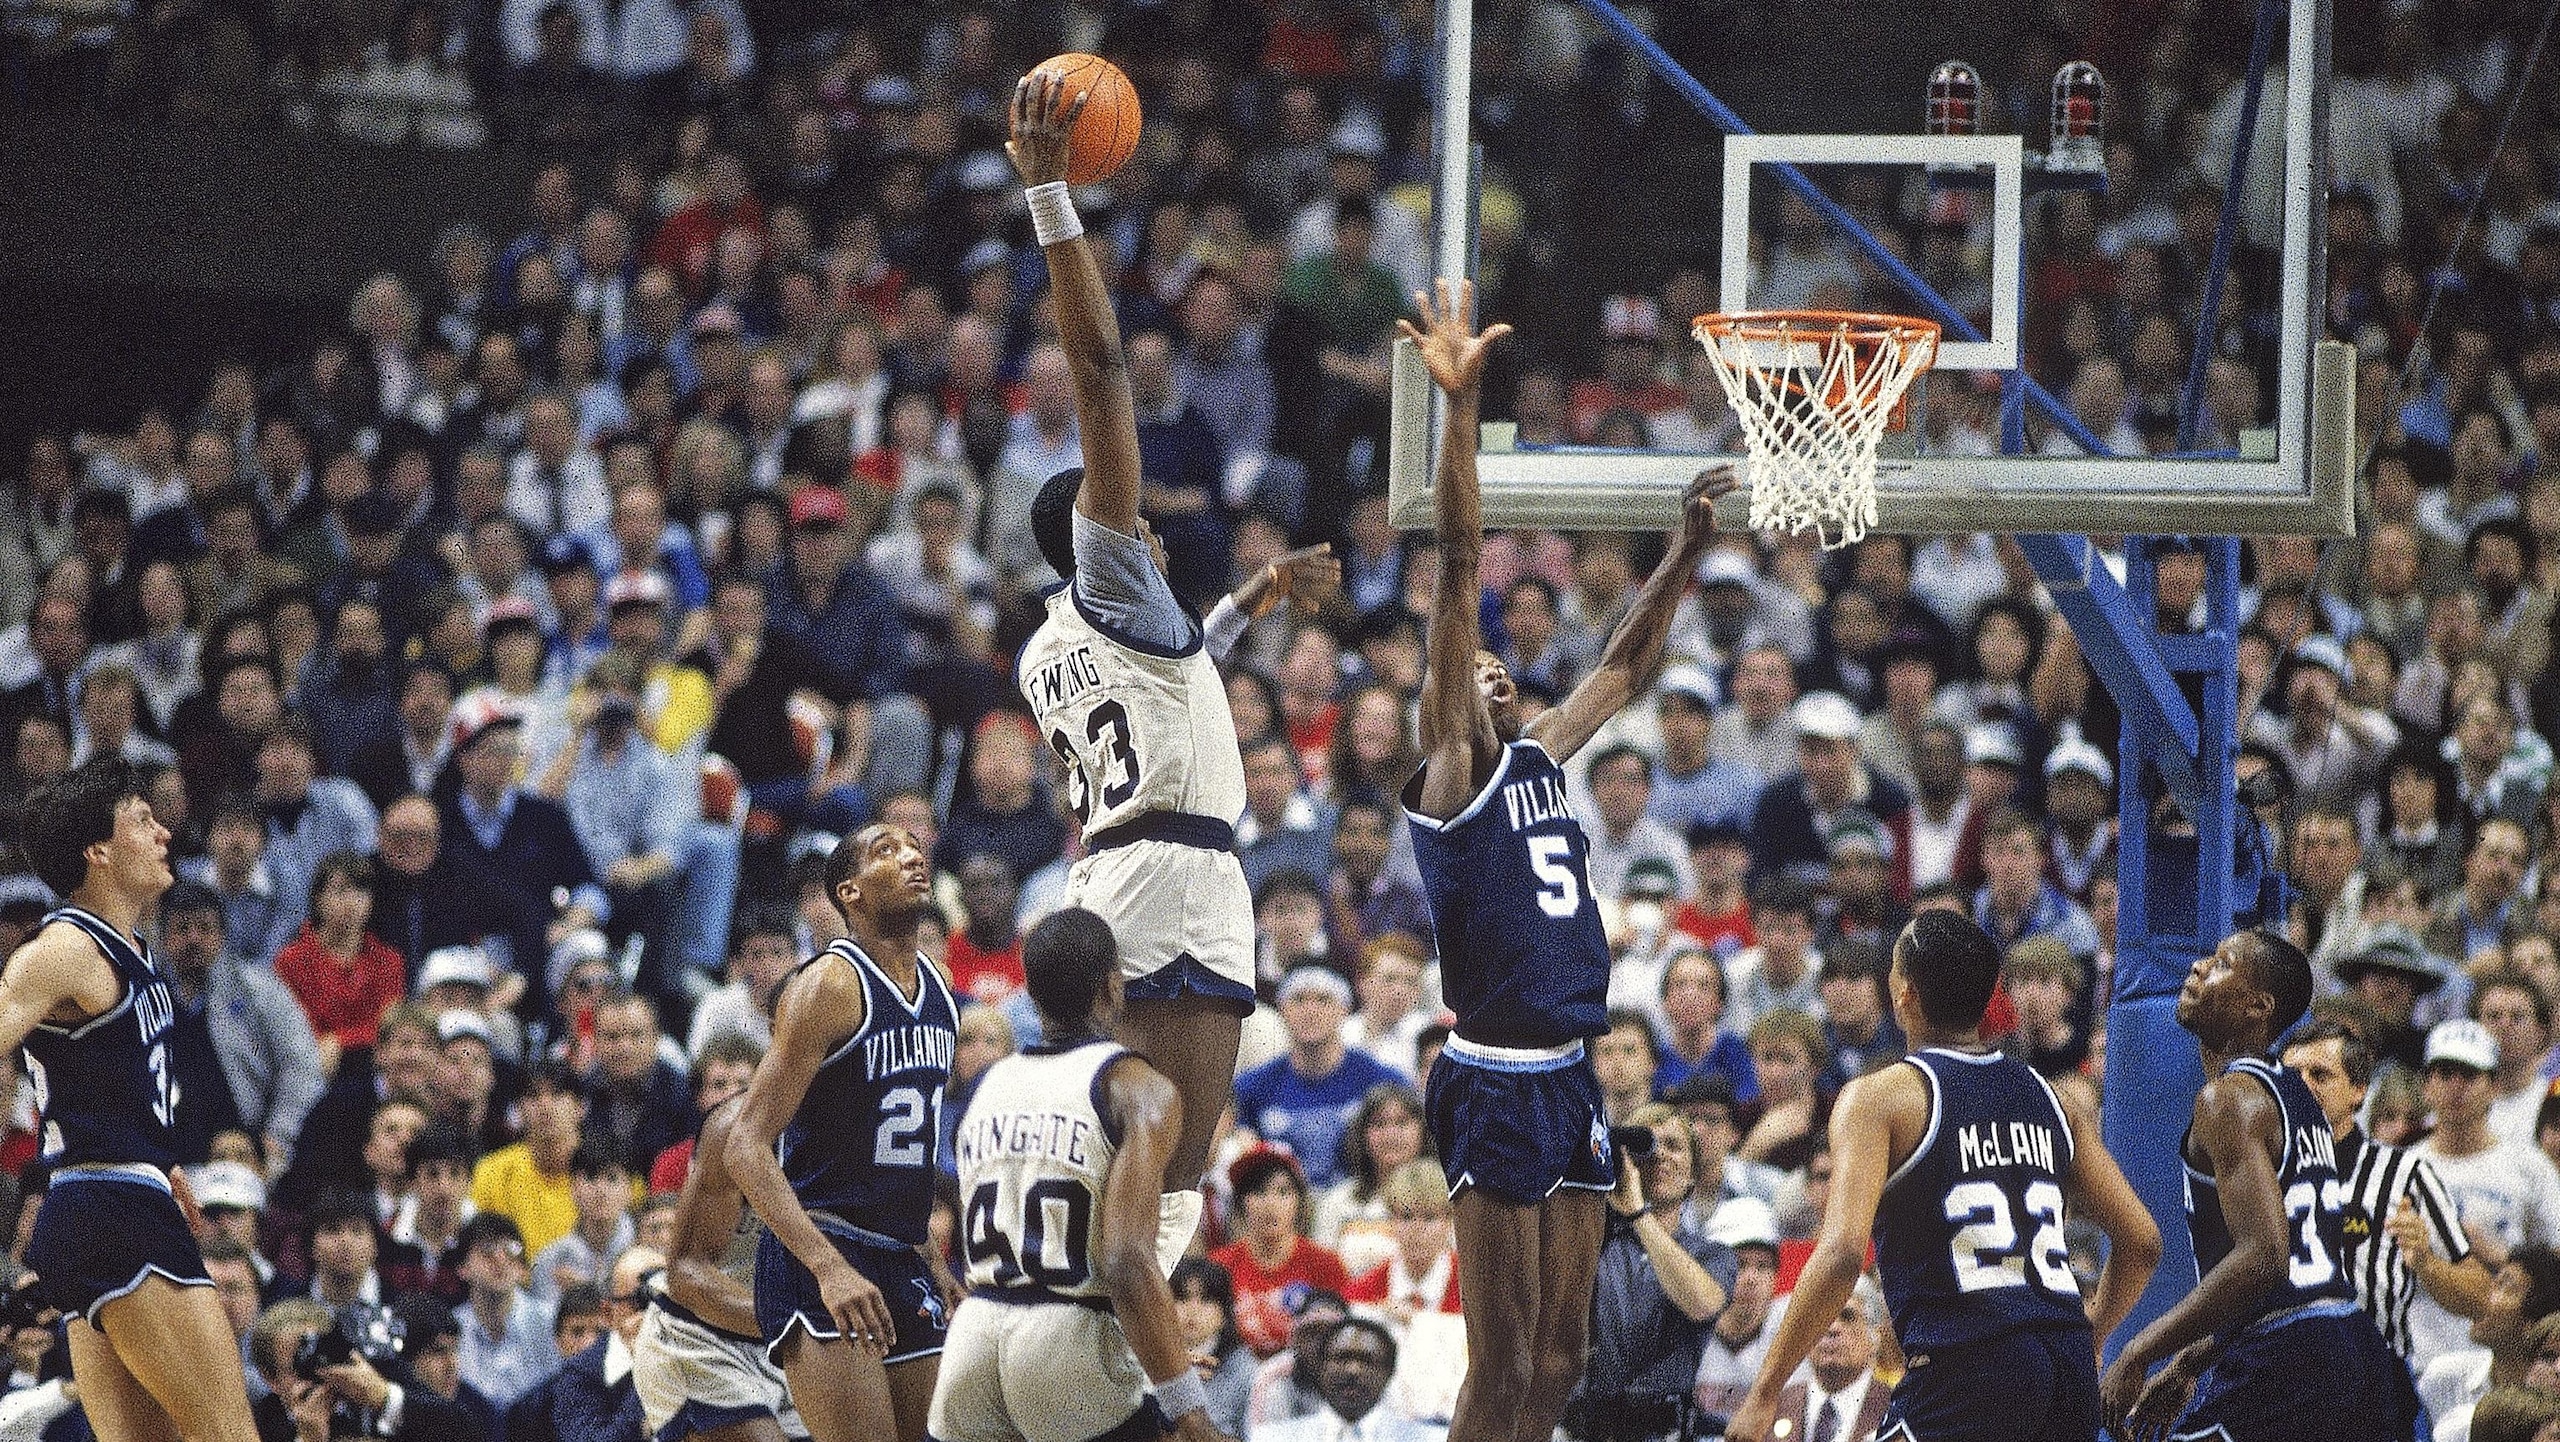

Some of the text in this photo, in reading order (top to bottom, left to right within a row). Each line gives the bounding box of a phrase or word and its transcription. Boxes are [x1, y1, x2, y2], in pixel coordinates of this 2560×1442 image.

[1029, 647, 1100, 720] EWING
[1051, 699, 1140, 826] 33
[1527, 835, 1597, 917] 5
[874, 1086, 945, 1166] 21
[1957, 1121, 2055, 1174] McLAIN
[966, 1179, 1092, 1288] 40
[1944, 1181, 2082, 1296] 22
